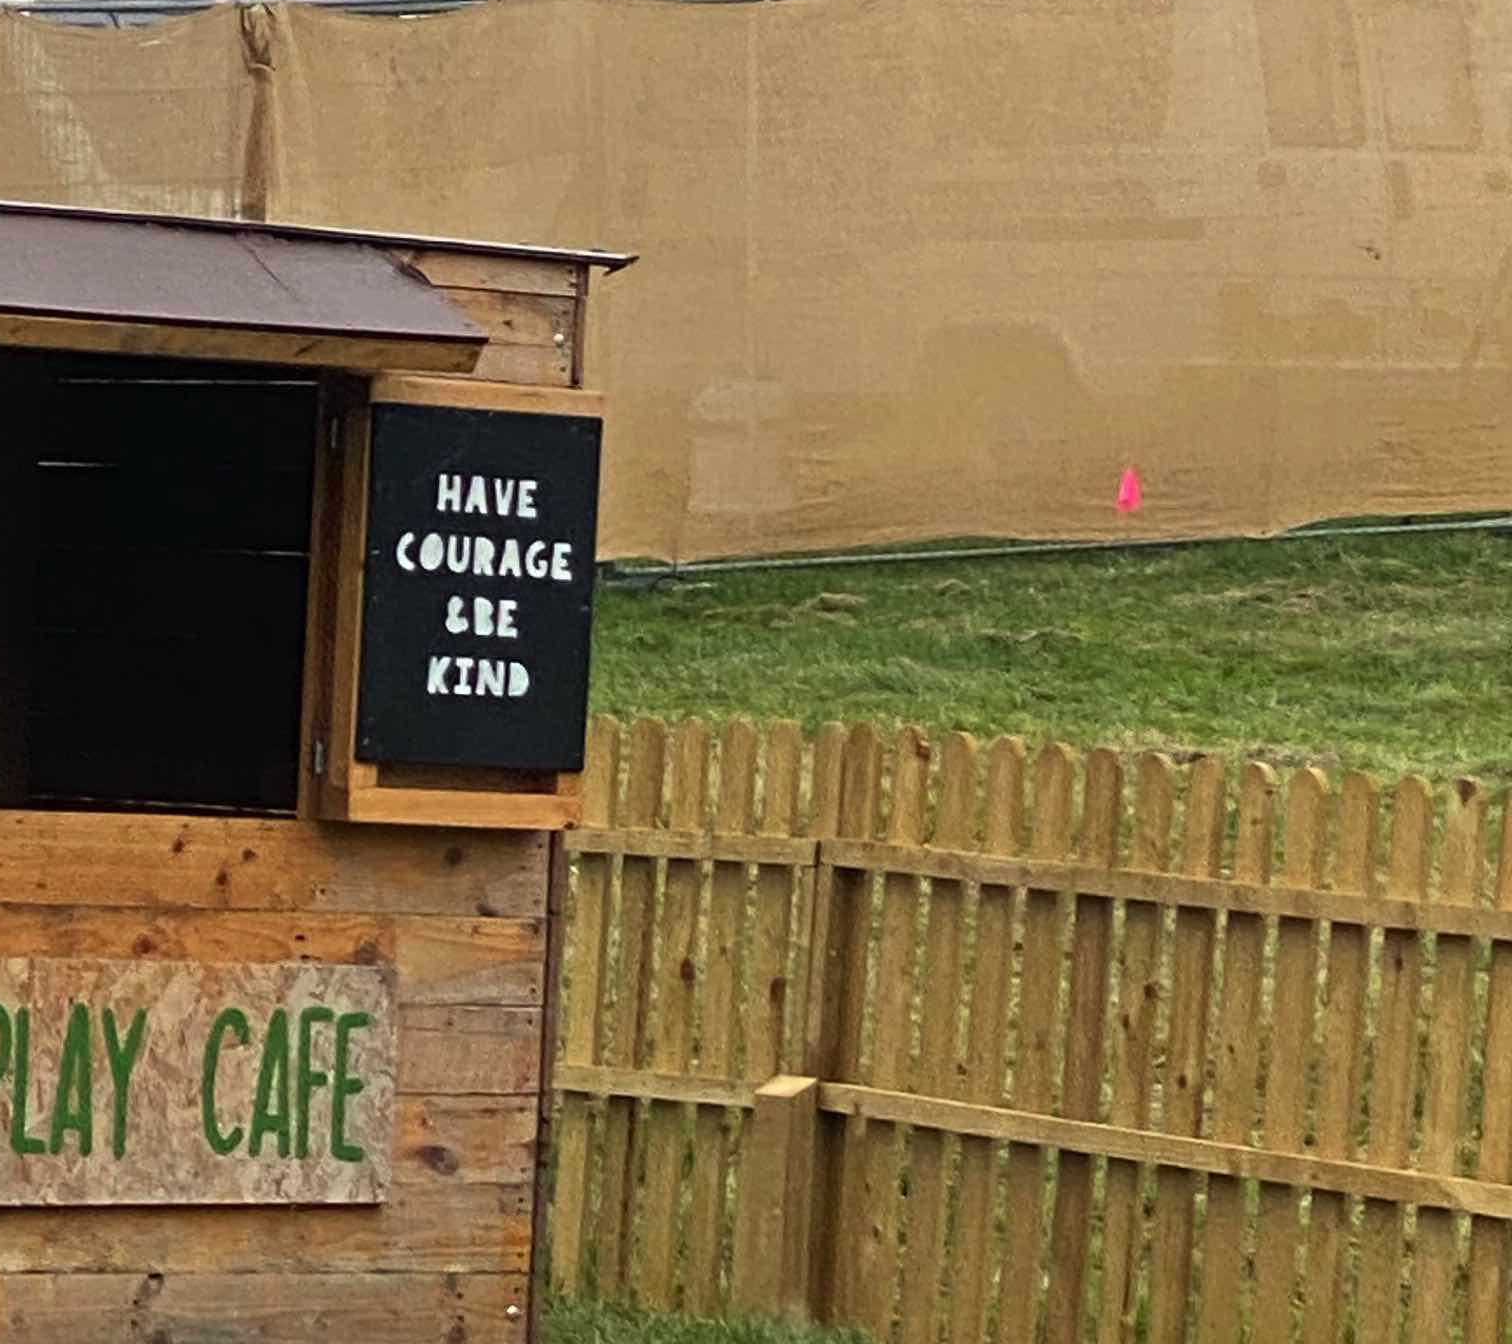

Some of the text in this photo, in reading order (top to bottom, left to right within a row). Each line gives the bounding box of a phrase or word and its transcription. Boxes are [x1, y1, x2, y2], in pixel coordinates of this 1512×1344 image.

[437, 473, 538, 518] HAVE
[396, 531, 572, 581] COURAGE
[426, 655, 530, 697] KIND
[201, 1005, 370, 1163] CAFE
